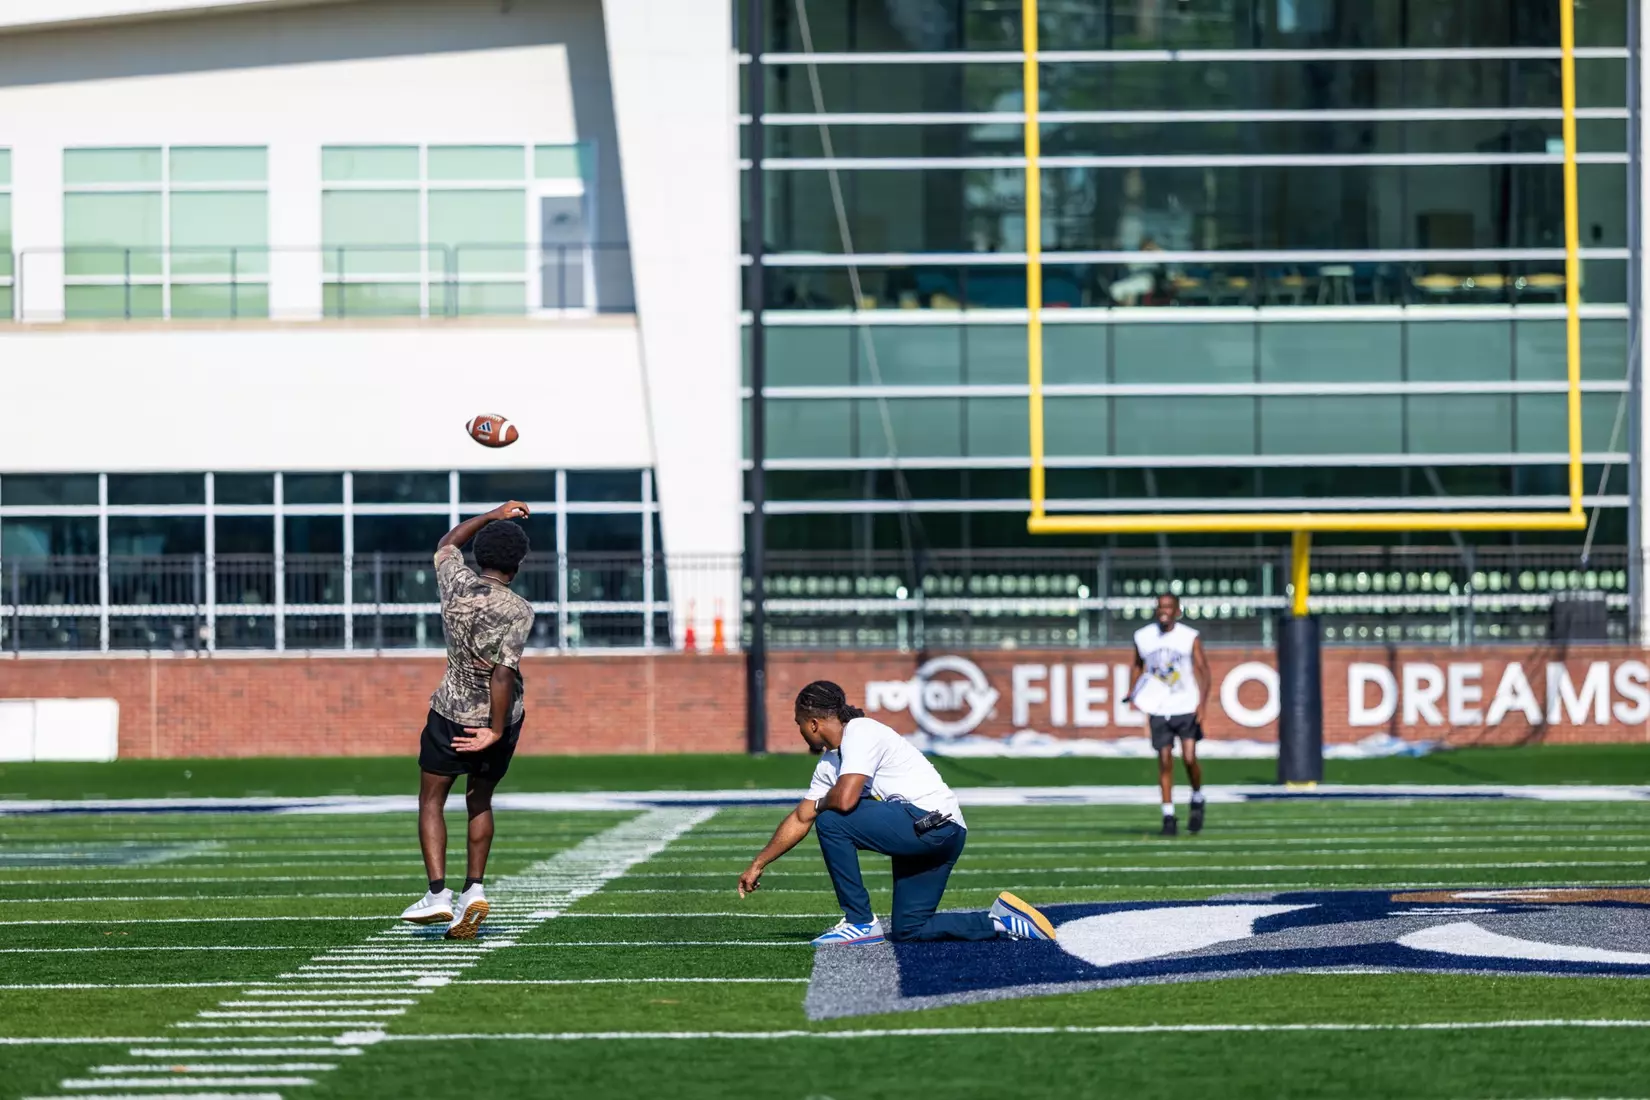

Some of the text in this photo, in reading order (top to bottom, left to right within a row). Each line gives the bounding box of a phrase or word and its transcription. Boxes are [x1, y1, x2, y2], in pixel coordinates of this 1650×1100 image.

[1012, 660, 1650, 728] FIEL O DREAMS
